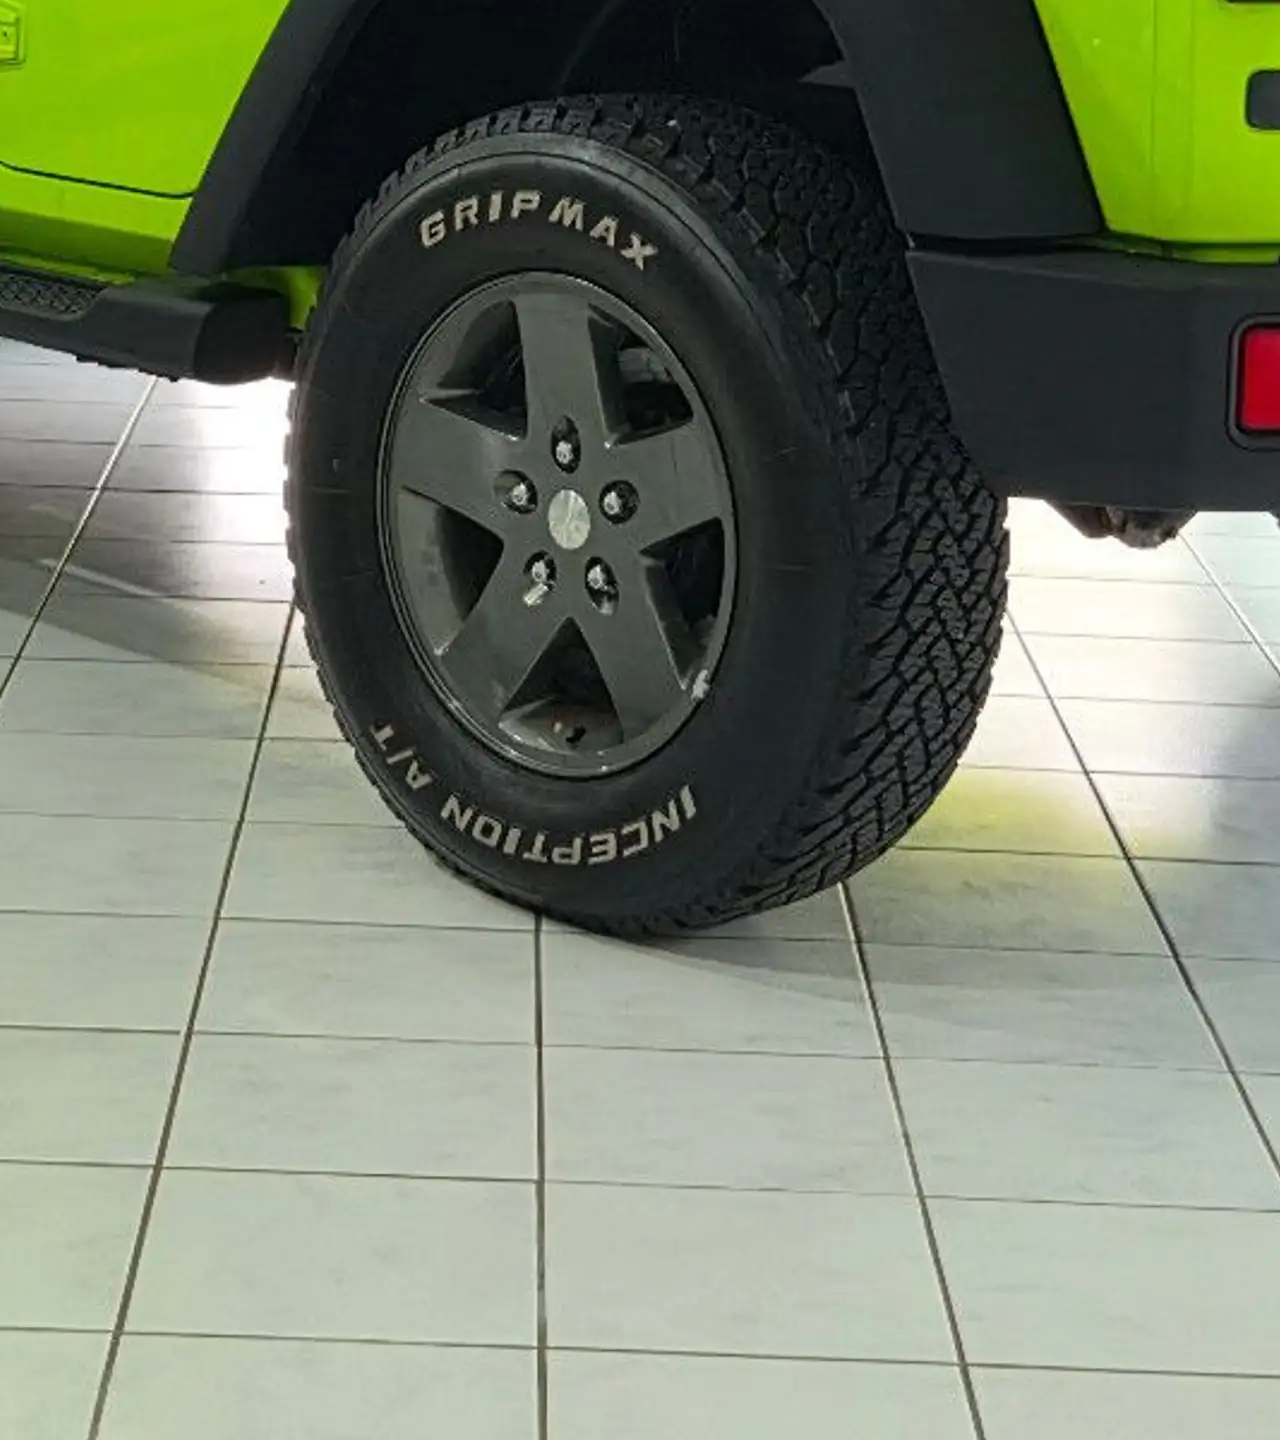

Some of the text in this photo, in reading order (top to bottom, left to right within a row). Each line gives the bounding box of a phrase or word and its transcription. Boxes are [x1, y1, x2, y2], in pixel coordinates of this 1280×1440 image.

[419, 189, 659, 271] GRIPMAX
[371, 716, 697, 866] INCEPTION A/T
